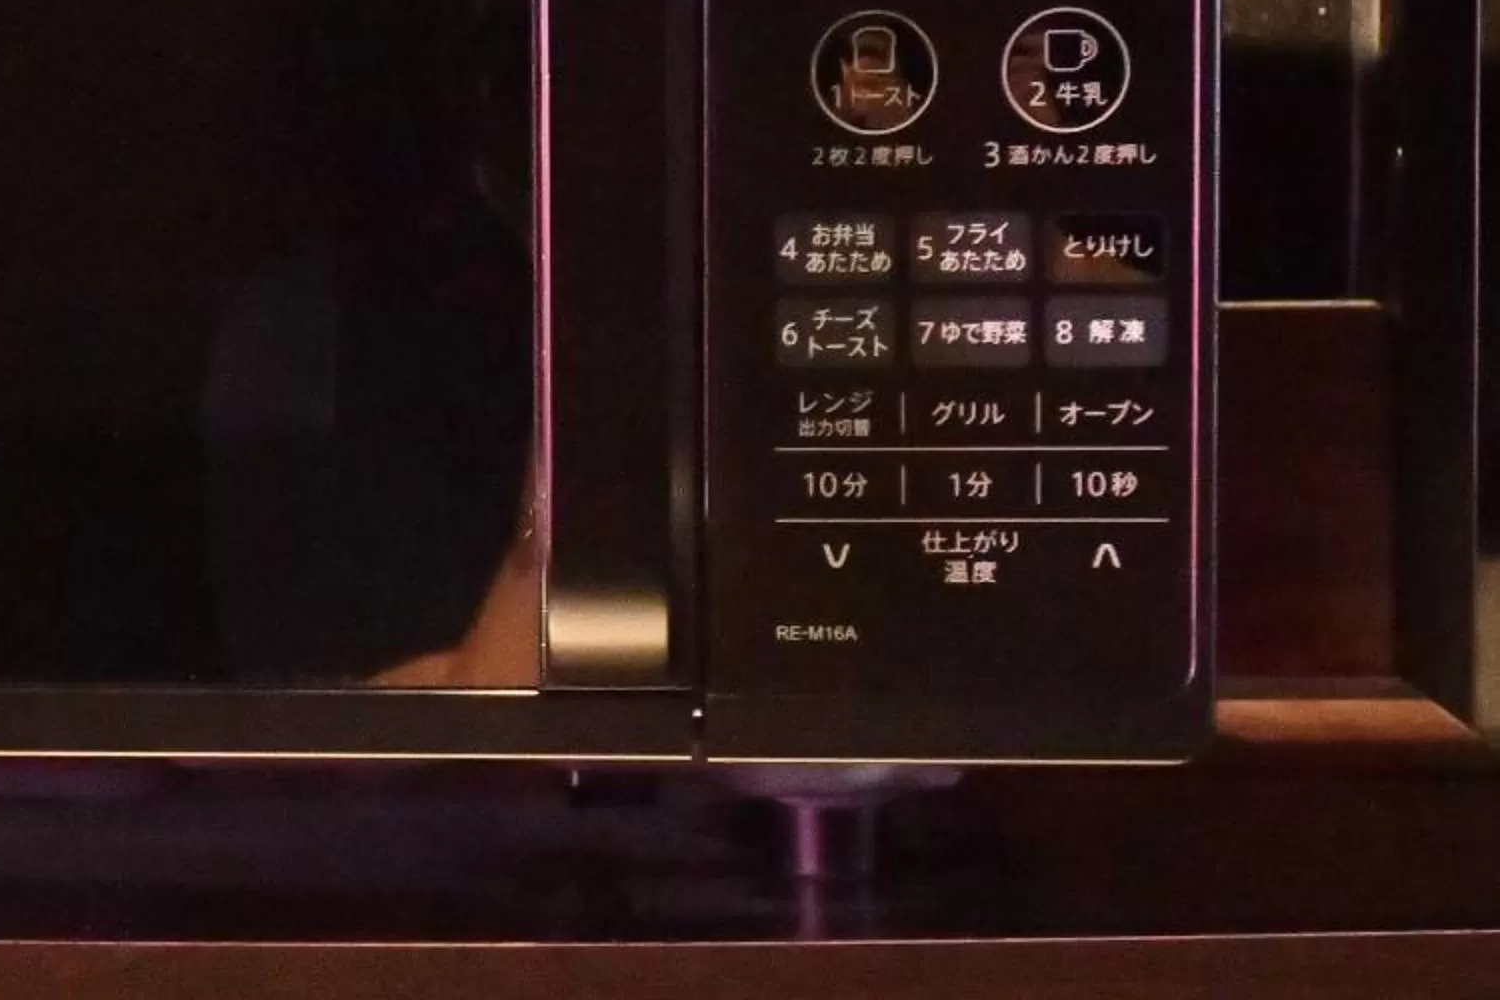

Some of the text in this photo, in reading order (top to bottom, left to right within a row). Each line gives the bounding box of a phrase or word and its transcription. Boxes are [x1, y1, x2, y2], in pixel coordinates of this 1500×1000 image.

[849, 82, 923, 108] トースト
[1028, 81, 1108, 107] 2 牛乳
[984, 140, 1001, 169] 3
[811, 223, 875, 247] お弁当
[947, 221, 1009, 245] フライ
[779, 237, 799, 261] 4
[917, 235, 934, 261] 5
[1061, 233, 1156, 261] とりけし
[804, 250, 892, 274] あたため
[939, 248, 1027, 273] あたため
[811, 305, 879, 331] チーズ
[781, 321, 799, 347] 6
[1055, 318, 1145, 345] 8 解凍
[807, 334, 889, 358] トースト
[798, 389, 875, 415] レンジ
[931, 400, 1006, 426] グリル
[1059, 399, 1154, 426] オープン
[803, 471, 868, 499] 10分
[949, 471, 993, 498] 1分
[1072, 471, 1138, 498] 10秒
[920, 529, 1020, 555] 仕上がり
[943, 559, 998, 585] 温度
[775, 624, 858, 642] RE-M16A
